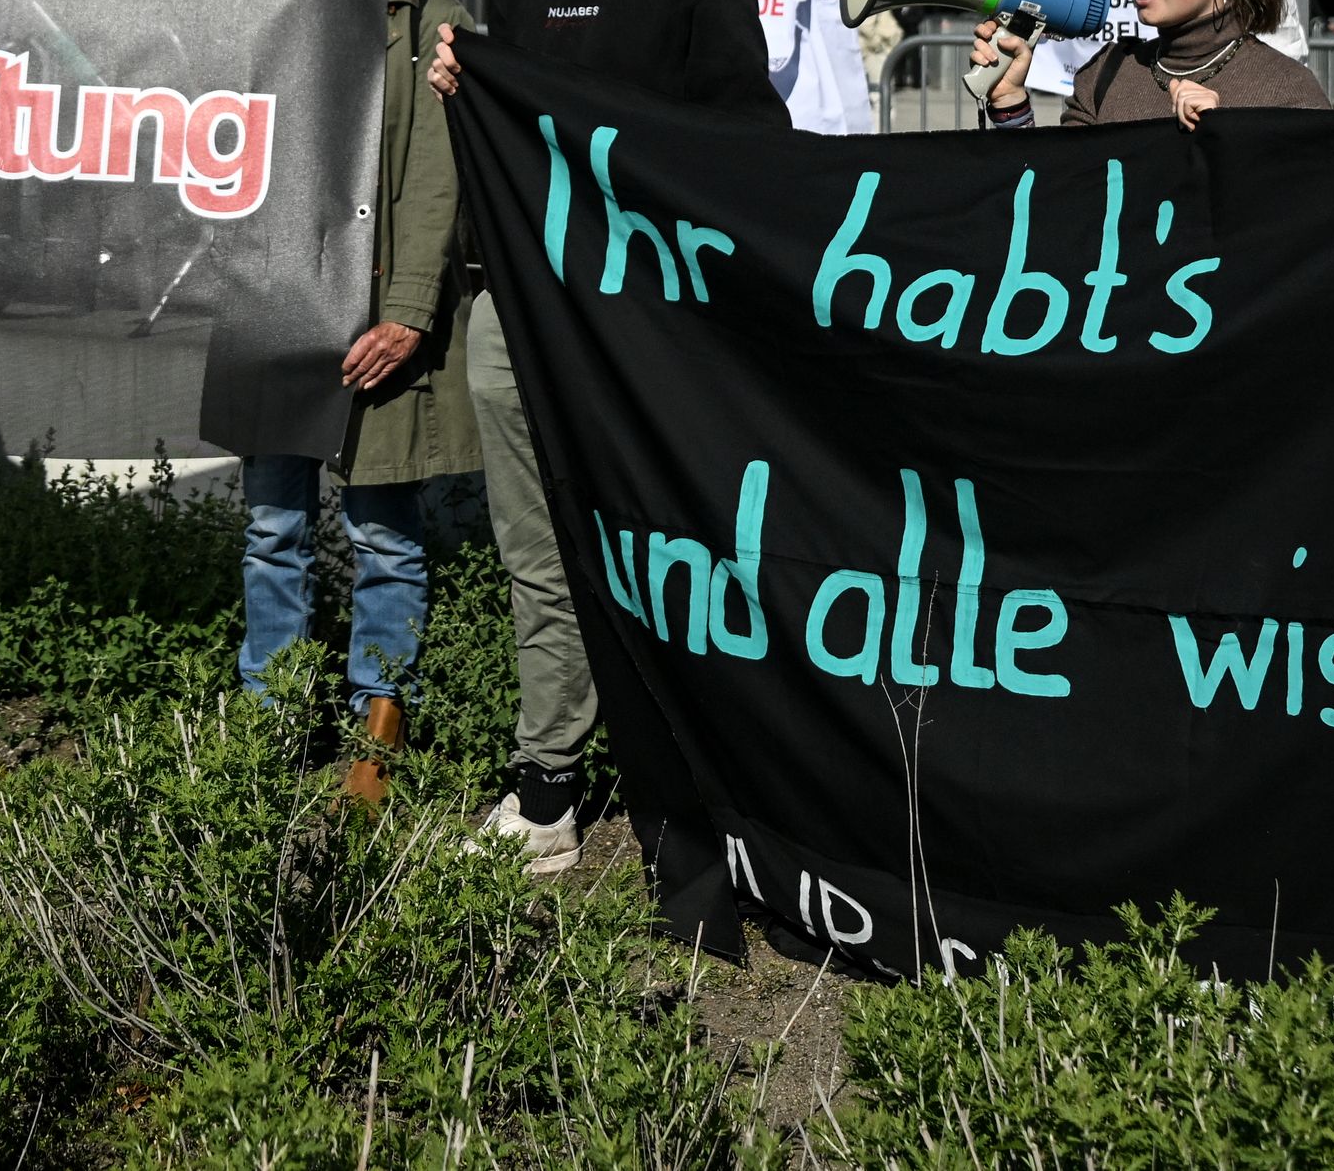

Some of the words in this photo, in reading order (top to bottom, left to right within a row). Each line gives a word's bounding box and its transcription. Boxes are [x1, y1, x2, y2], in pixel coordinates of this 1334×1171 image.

[538, 115, 735, 304] Ihr
[812, 159, 1220, 355] habt's
[592, 460, 769, 661] und
[805, 468, 1071, 698] alle
